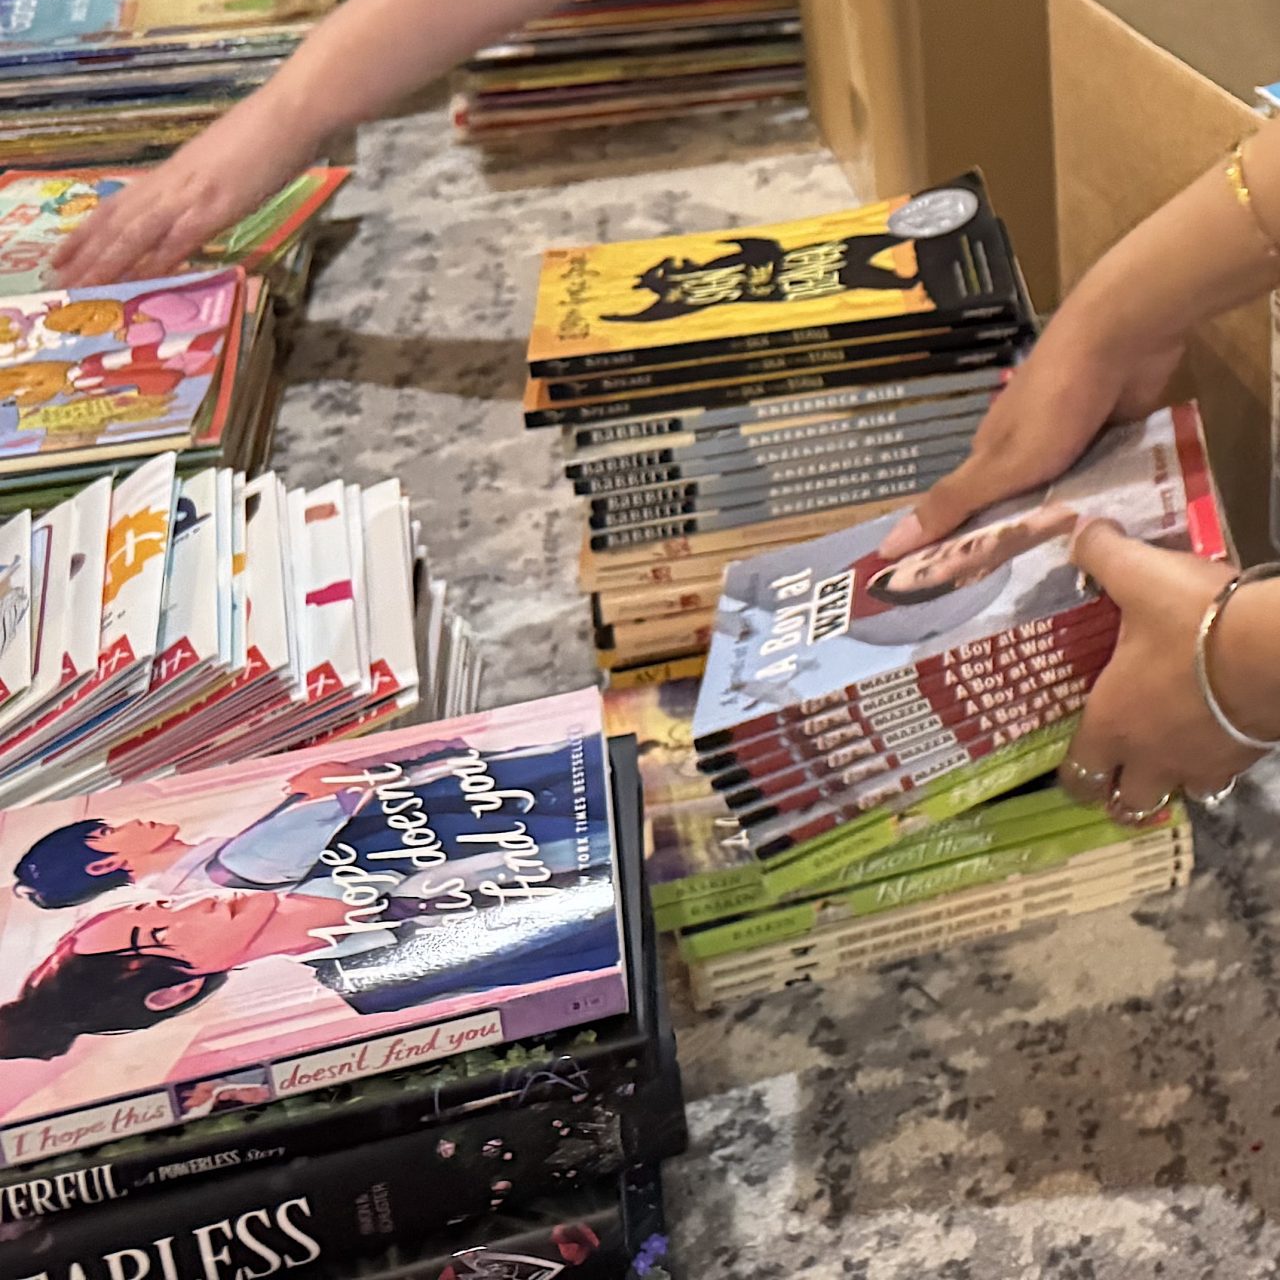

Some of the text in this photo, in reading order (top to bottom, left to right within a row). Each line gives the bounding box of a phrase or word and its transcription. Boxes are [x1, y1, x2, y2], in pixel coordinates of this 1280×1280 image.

[769, 568, 812, 601] at
[813, 571, 850, 641] WAR
[755, 653, 798, 680] A
[944, 651, 956, 667] A
[960, 639, 992, 659] Boy
[998, 629, 1017, 647] at
[1019, 617, 1054, 638] War
[945, 669, 958, 686] A
[960, 659, 994, 680] Boy
[999, 648, 1018, 666] at
[1020, 634, 1055, 657] War
[955, 684, 969, 700] A
[971, 673, 1004, 693] Boy
[1009, 662, 1028, 680] at
[1030, 650, 1065, 671] War
[966, 699, 980, 716] A
[981, 687, 1014, 709] Boy
[1018, 676, 1038, 695] at
[1040, 664, 1073, 685] War
[980, 715, 993, 731] A
[995, 702, 1028, 725] Boy
[1032, 690, 1051, 710] at
[1052, 677, 1087, 699] War
[993, 730, 1006, 747] A
[319, 762, 447, 868] doesn't
[448, 749, 562, 906] find you
[574, 795, 588, 834] TIMES
[578, 841, 591, 870] YORK
[308, 843, 402, 947] hope
[13, 1019, 502, 1157] I hope this doesn't find you
[157, 1148, 242, 1182] POWERLESS
[245, 1145, 286, 1164] Story
